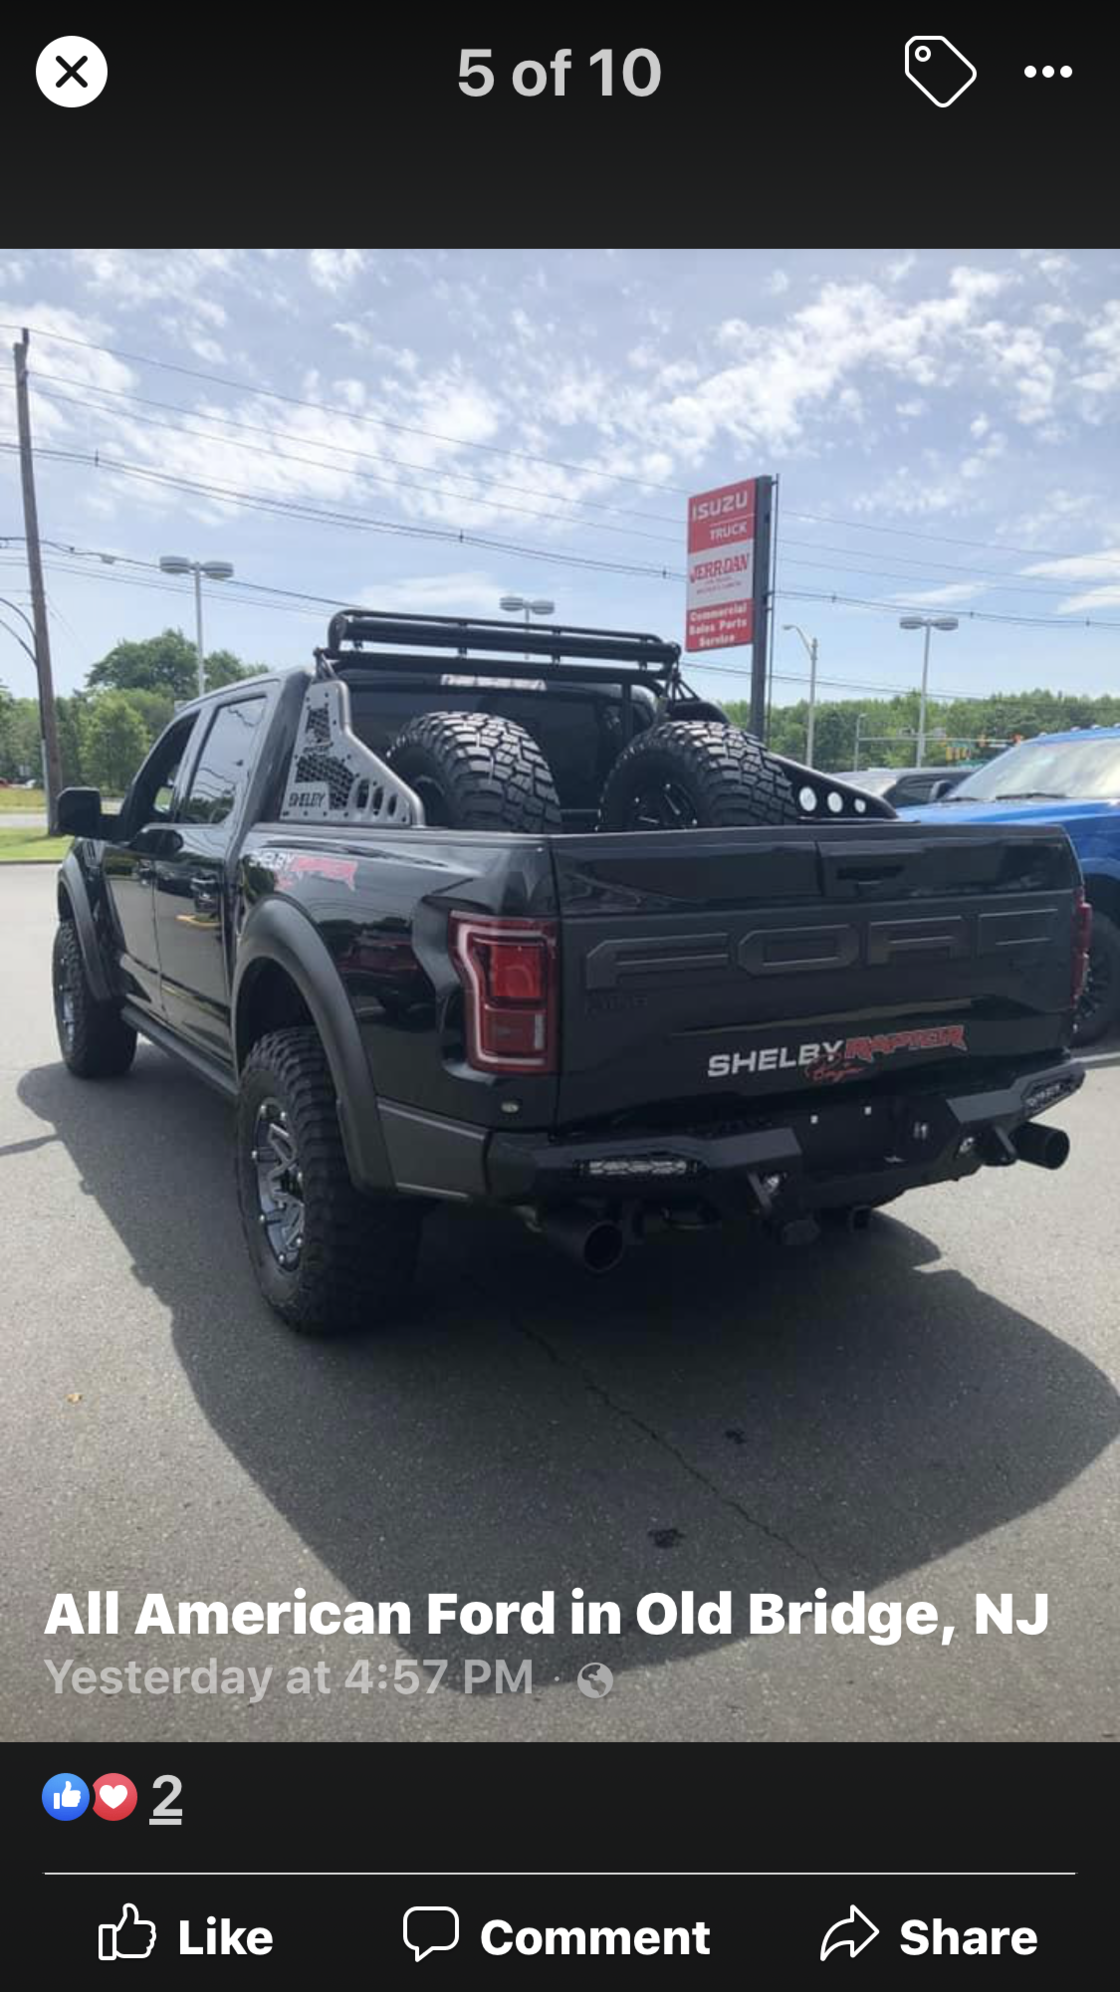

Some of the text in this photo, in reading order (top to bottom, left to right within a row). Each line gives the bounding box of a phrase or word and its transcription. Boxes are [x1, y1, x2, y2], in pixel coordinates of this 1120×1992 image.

[692, 491, 748, 520] ISUZU
[709, 522, 747, 540] TRUCK
[690, 602, 747, 622] Commercial
[689, 618, 747, 636] Sales Parts
[699, 633, 735, 648] Service
[288, 792, 326, 808] SHELBY
[707, 1025, 968, 1077] SHELBY RAPTOR
